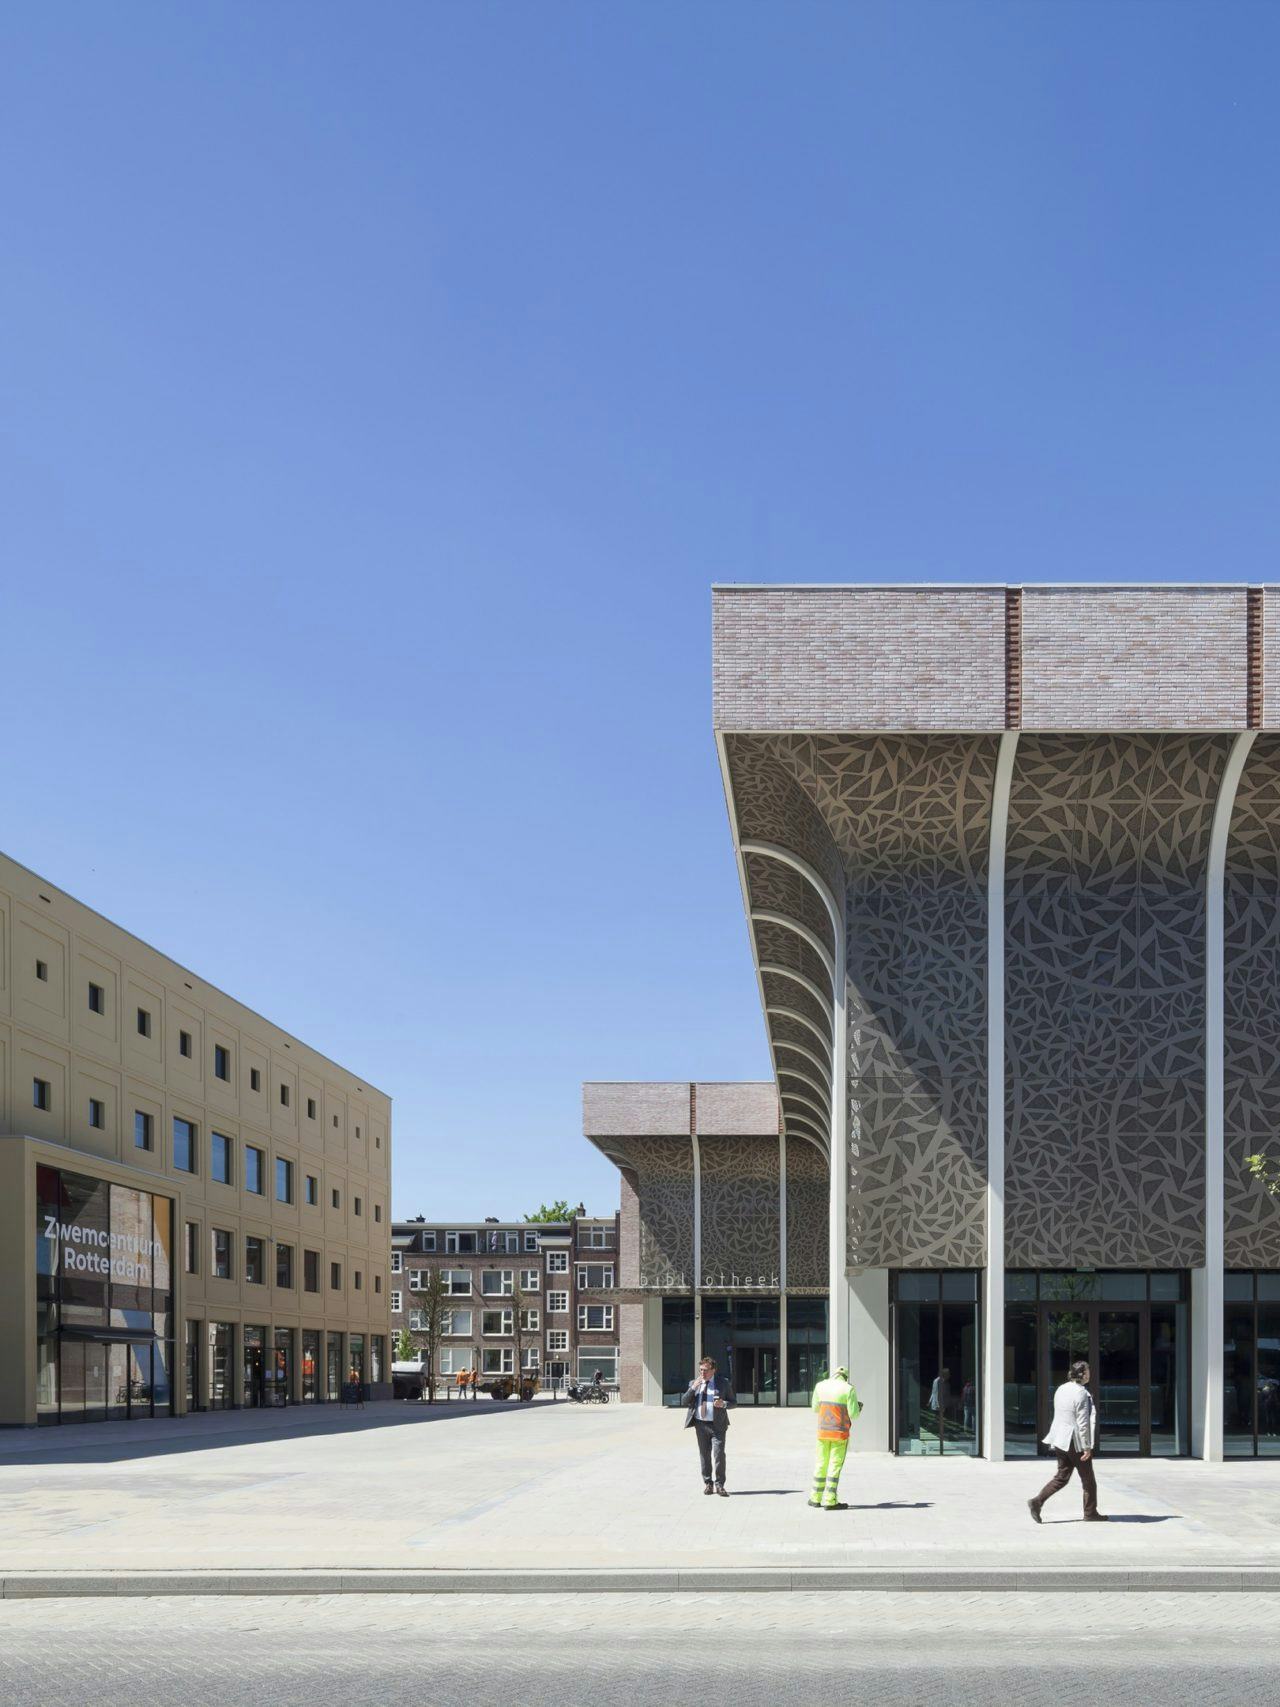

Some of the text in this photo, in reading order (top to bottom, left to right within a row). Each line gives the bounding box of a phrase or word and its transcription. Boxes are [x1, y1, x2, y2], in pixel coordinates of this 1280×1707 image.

[44, 1215, 161, 1257] Zwemcentrum
[64, 1247, 149, 1279] Rotterdam
[640, 1271, 779, 1287] biblotheek
